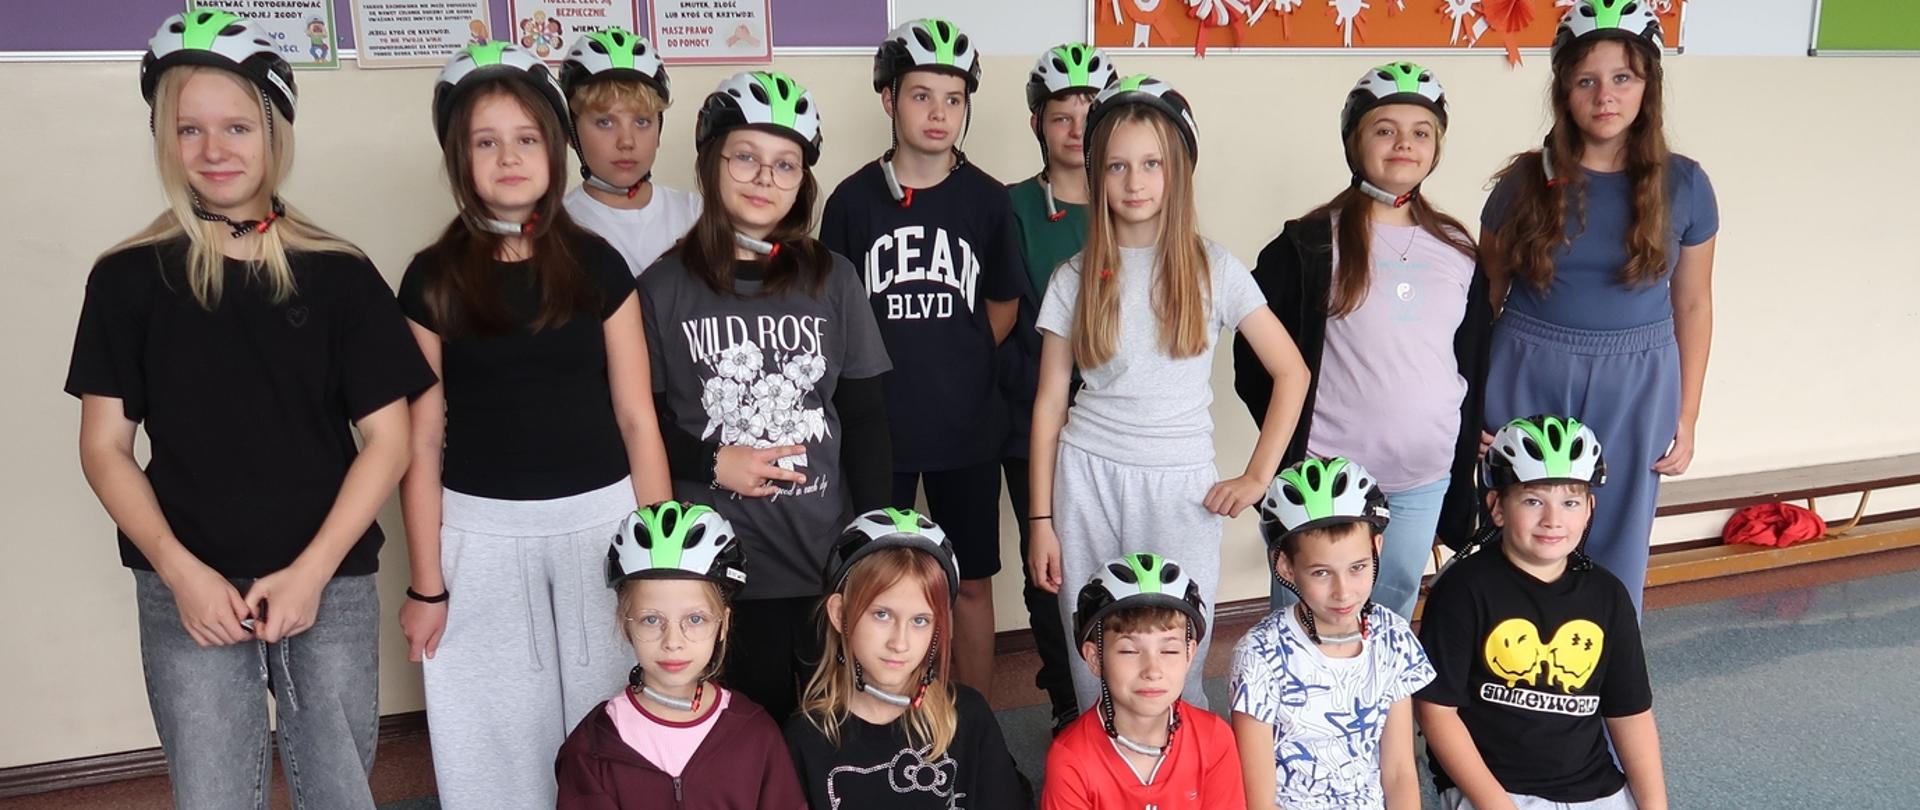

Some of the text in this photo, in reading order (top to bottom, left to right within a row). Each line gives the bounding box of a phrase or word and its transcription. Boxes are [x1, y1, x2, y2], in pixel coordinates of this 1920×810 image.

[662, 26, 713, 34] MASZ PRAWO
[667, 39, 709, 47] DO POMOCY
[886, 293, 953, 319] BLVD
[682, 315, 828, 363] WILD ROSE
